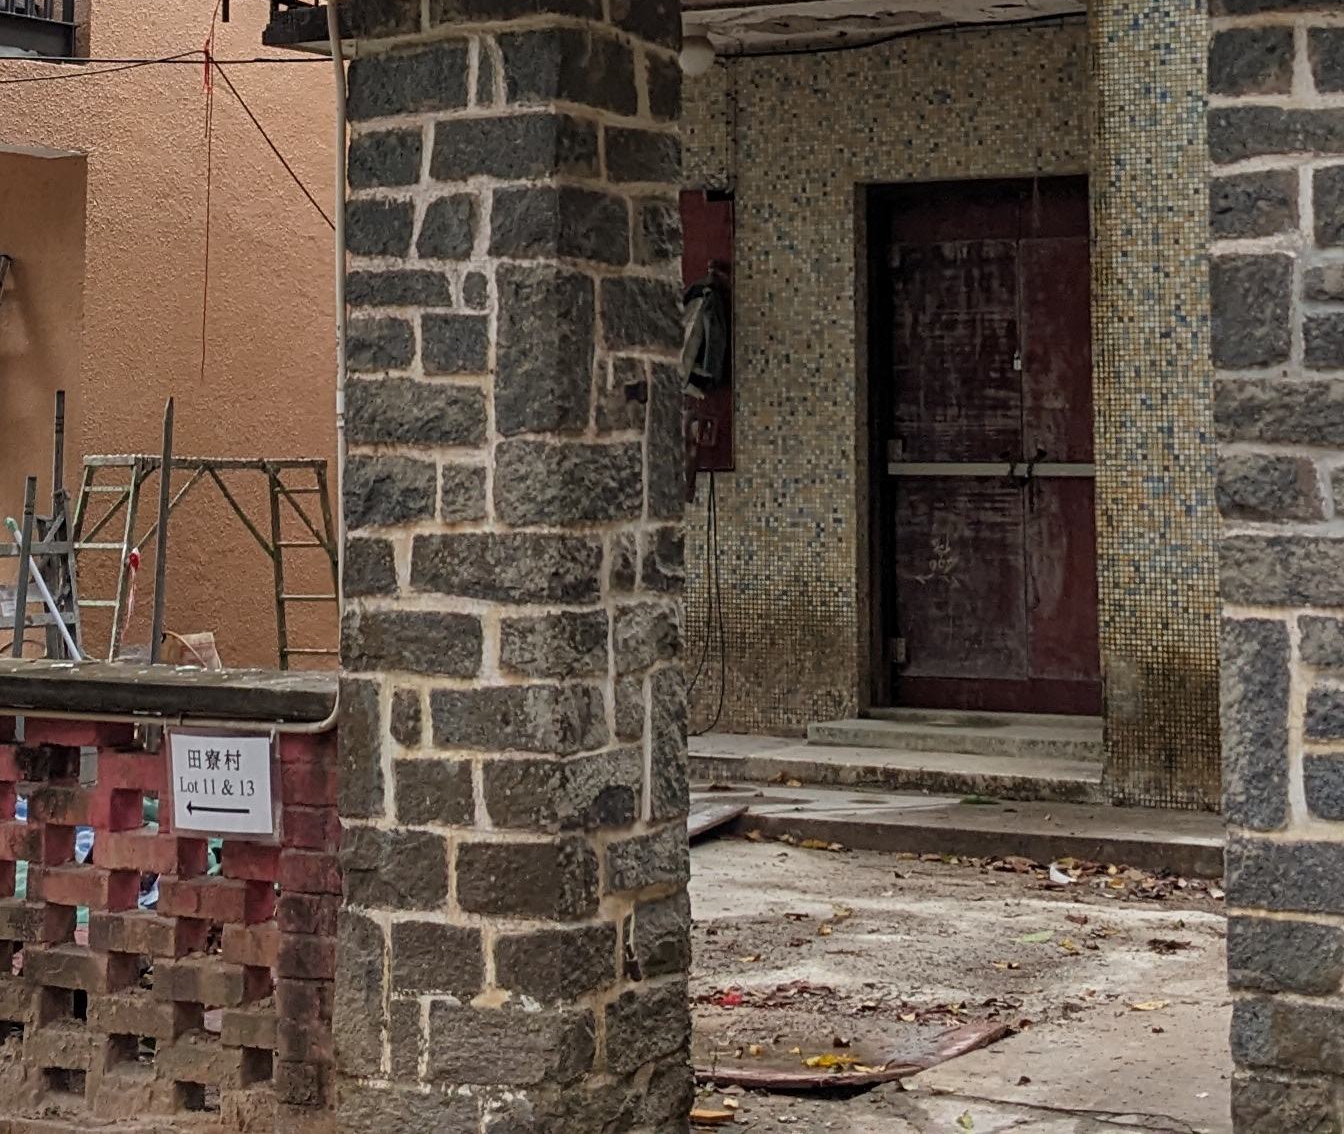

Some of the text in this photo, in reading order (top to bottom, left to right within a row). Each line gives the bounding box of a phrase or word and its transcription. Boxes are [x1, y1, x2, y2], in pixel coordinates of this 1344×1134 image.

[187, 748, 242, 772] 田寮村
[179, 776, 255, 797] Lot 11 & 13
